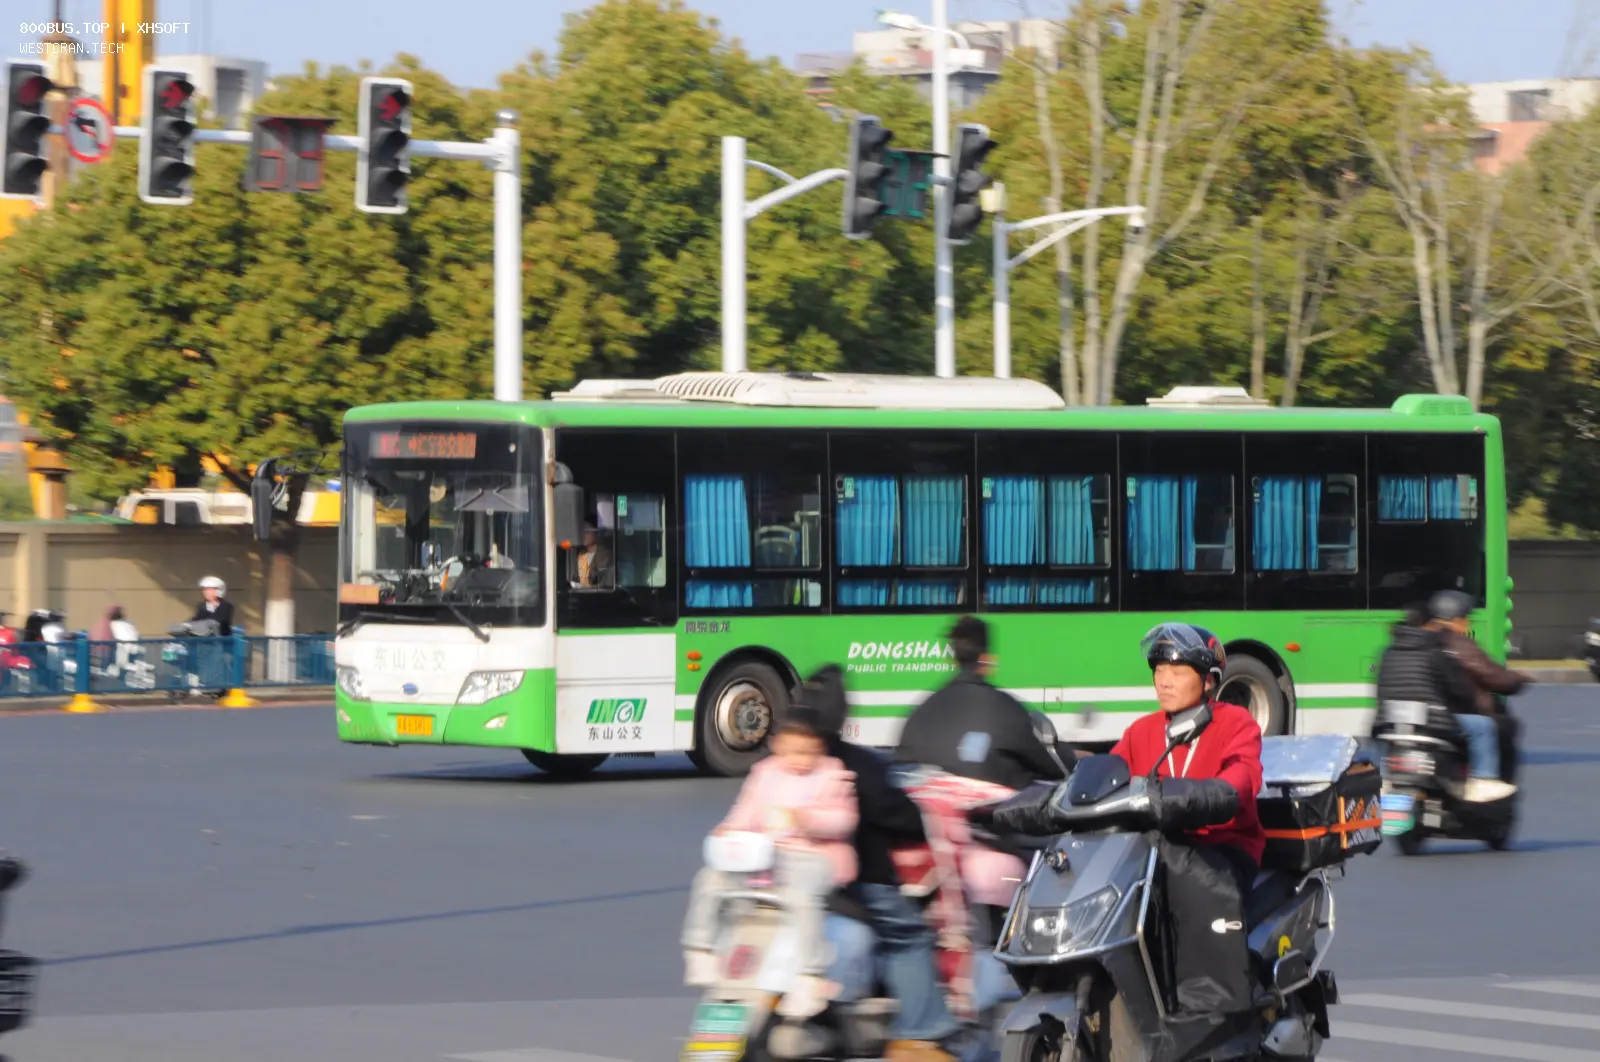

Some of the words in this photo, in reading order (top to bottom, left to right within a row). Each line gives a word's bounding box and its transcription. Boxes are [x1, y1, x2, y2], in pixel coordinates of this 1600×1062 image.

[847, 640, 957, 659] DONGSHAN
[372, 645, 446, 673] 东山公交
[846, 662, 887, 674] PUBLIC
[891, 662, 957, 673] TRANSPORT
[588, 726, 643, 741] 东山公交
